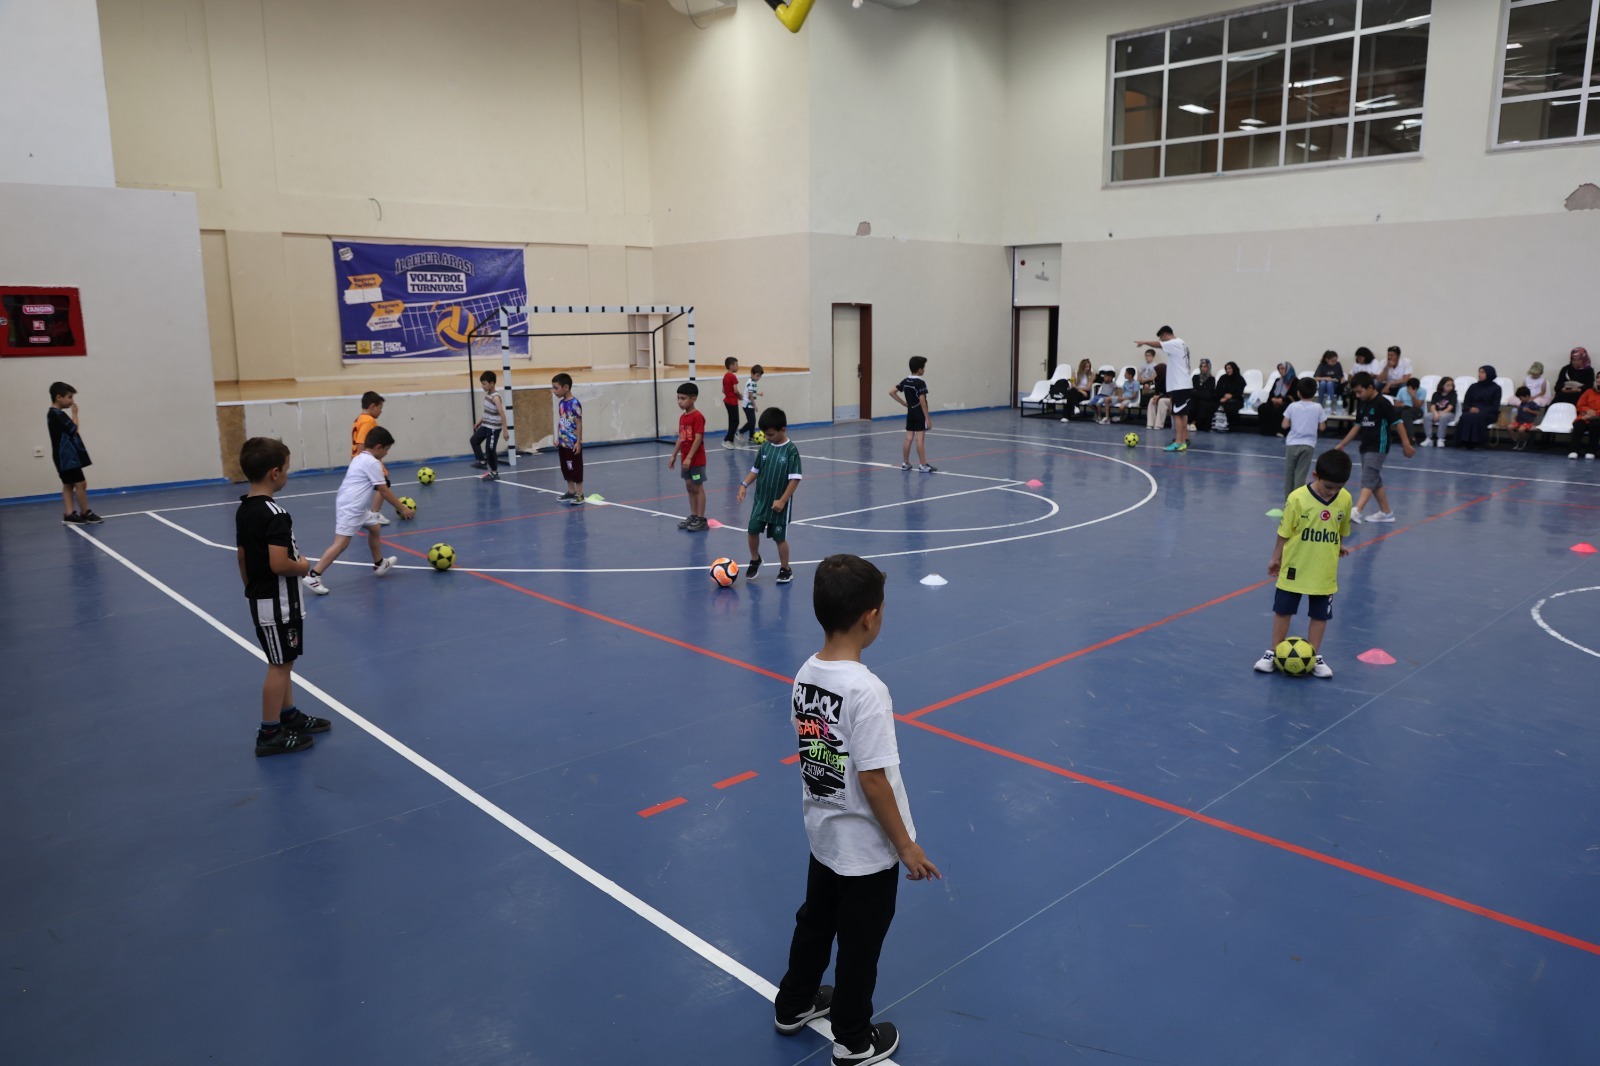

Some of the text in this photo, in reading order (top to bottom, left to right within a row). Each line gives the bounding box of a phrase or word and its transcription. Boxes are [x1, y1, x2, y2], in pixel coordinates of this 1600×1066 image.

[441, 253, 475, 276] ARASI
[409, 273, 464, 283] VOLEYBOL
[410, 284, 464, 292] TURNUVASI
[794, 684, 840, 722] BLACK
